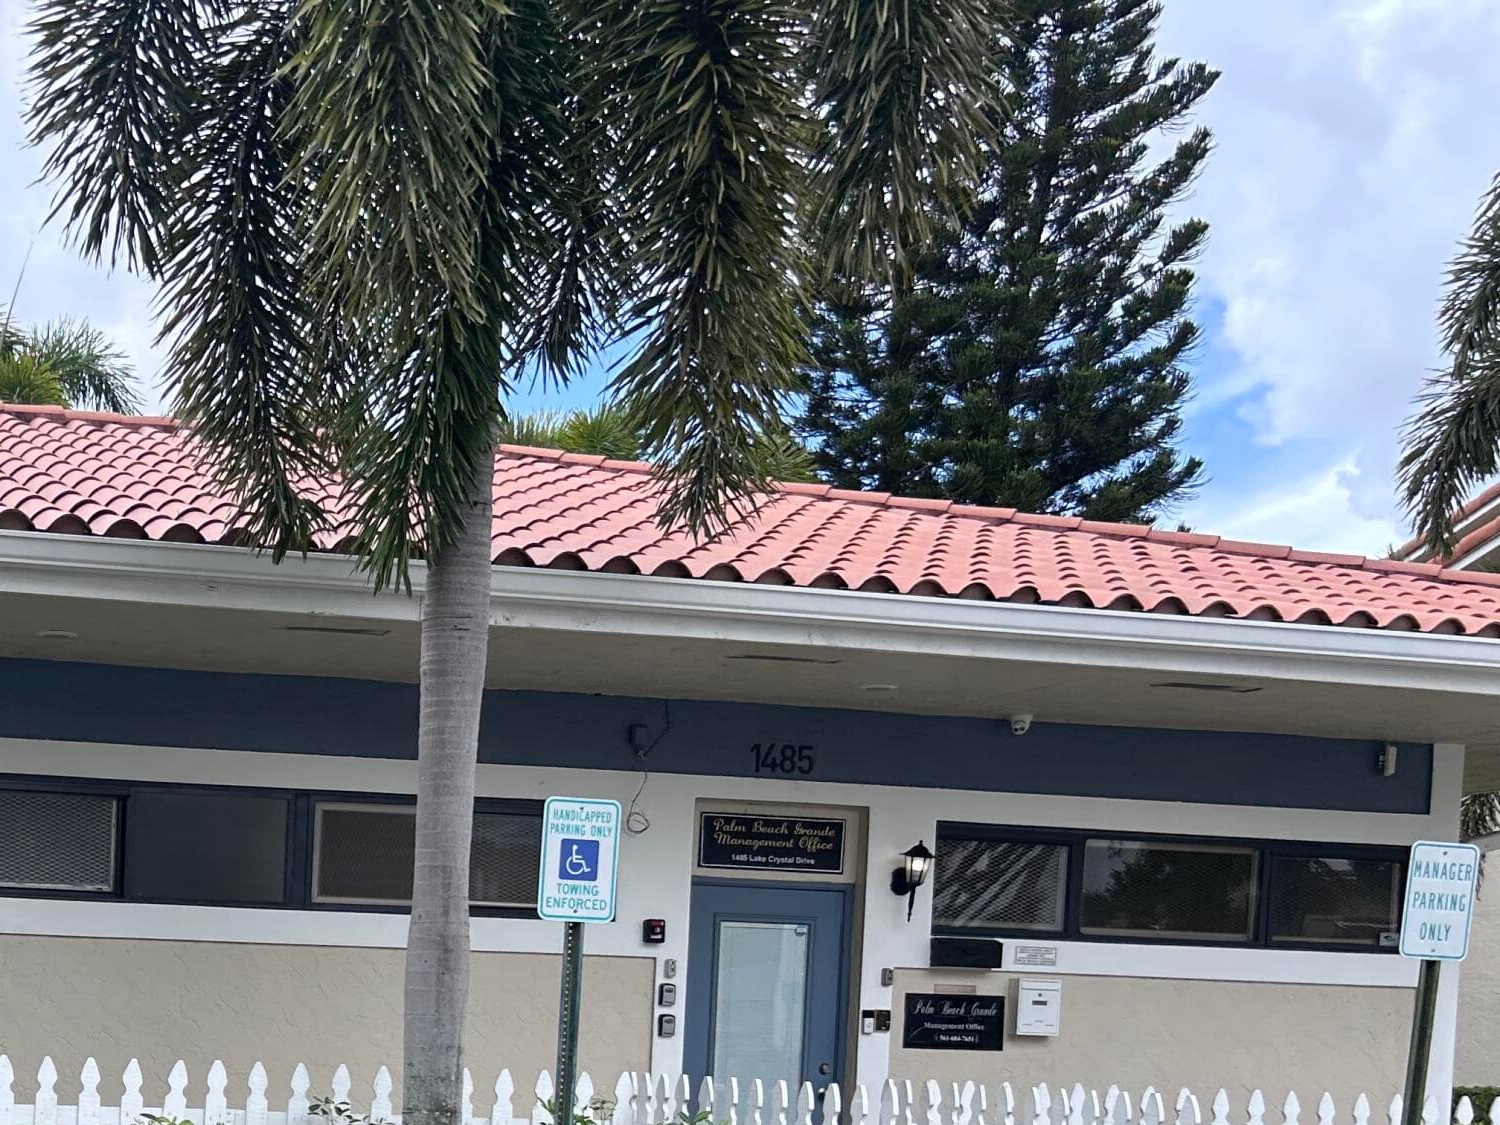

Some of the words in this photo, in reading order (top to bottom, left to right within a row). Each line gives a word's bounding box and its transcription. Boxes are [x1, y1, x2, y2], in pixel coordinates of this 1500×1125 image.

[750, 743, 814, 774] 1485
[553, 808, 612, 823] HANDICAPPED
[550, 823, 586, 836] PARKING
[590, 825, 612, 837] ONLY
[712, 818, 746, 832] Palm
[751, 820, 788, 834] Beach
[793, 823, 836, 837] Grande
[713, 832, 794, 850] Management
[798, 836, 834, 852] Office
[731, 854, 748, 862] 1485
[749, 855, 767, 863] Lake
[768, 855, 794, 864] Crystal
[795, 856, 815, 864] Drive
[1413, 860, 1473, 881] MANAGER
[557, 883, 599, 896] TOWING
[545, 897, 607, 911] ENFORCED
[1412, 892, 1466, 912] PARKING
[1419, 922, 1452, 942] ONLY
[911, 1000, 935, 1014] Palm
[941, 1001, 966, 1016] Beach
[971, 1001, 997, 1016] Grande
[923, 1022, 965, 1030] Management
